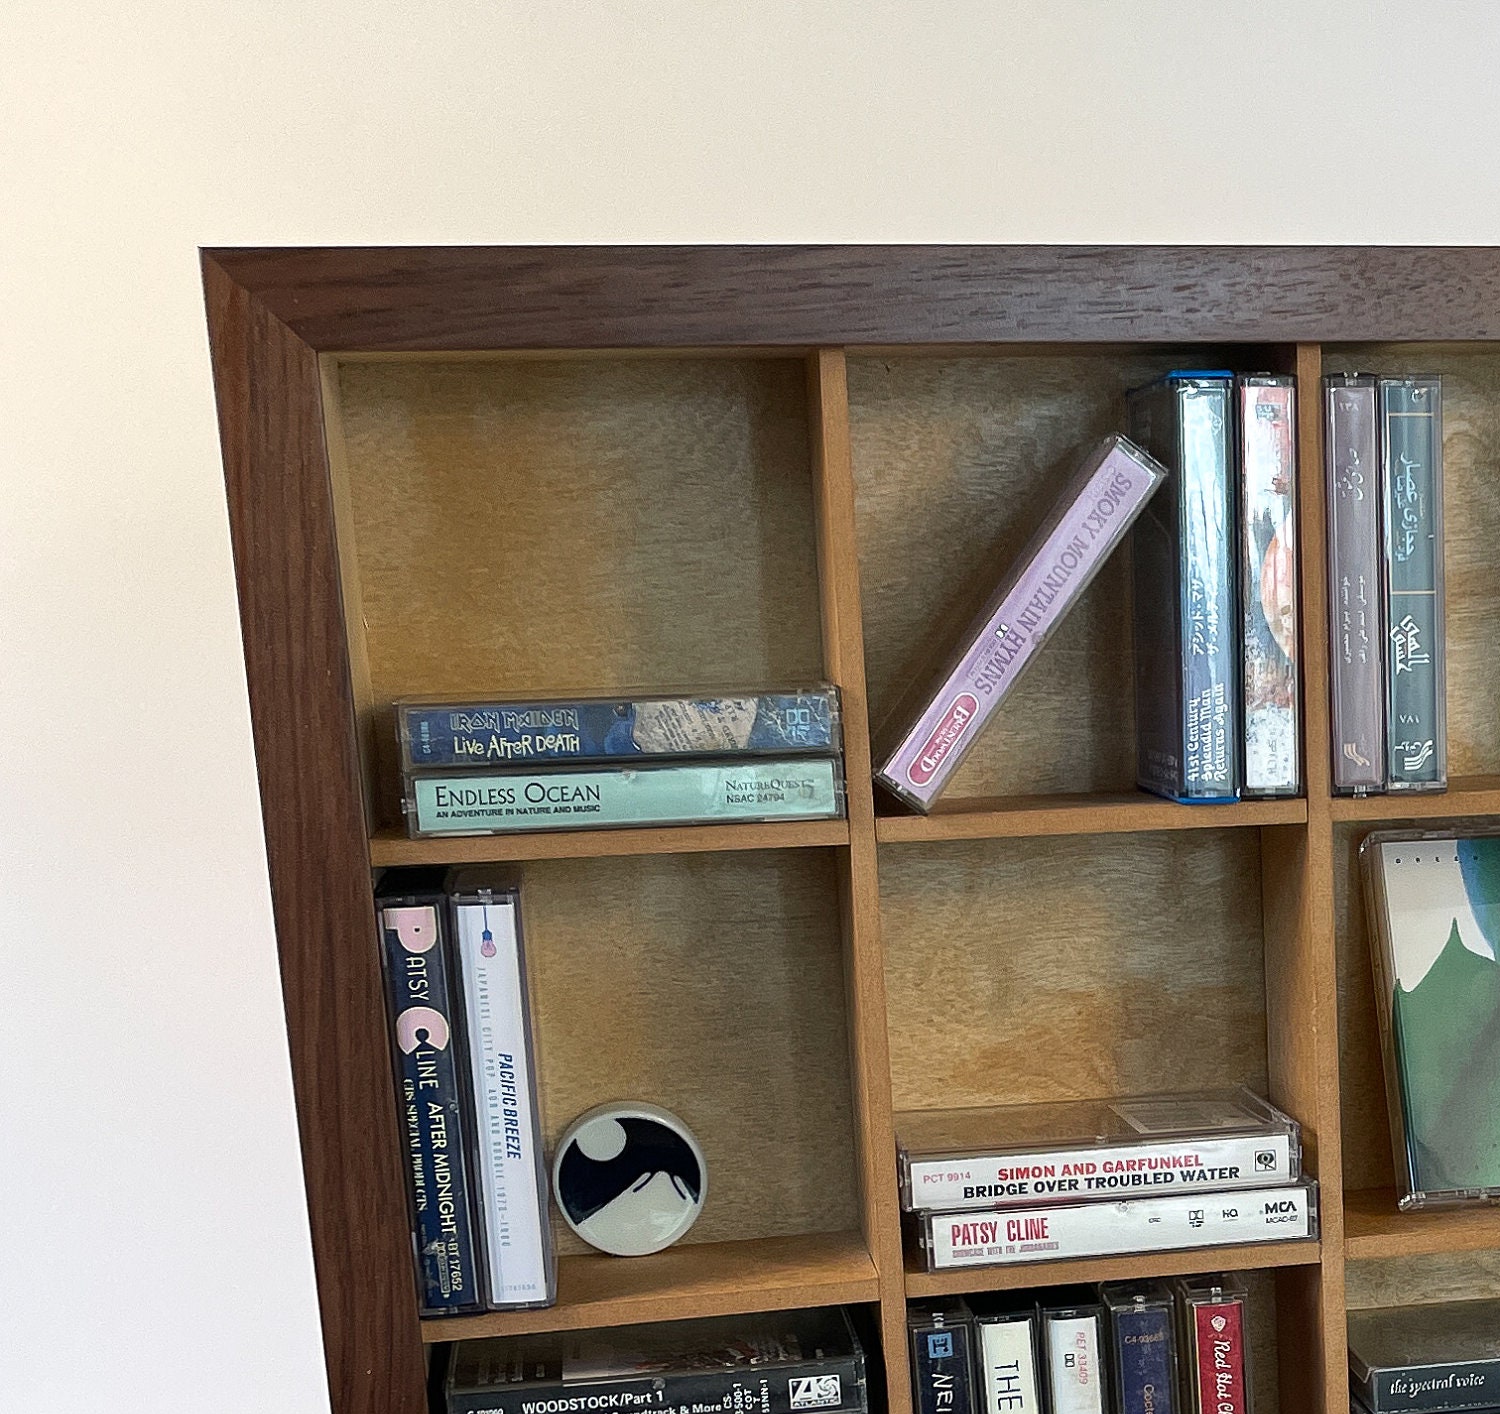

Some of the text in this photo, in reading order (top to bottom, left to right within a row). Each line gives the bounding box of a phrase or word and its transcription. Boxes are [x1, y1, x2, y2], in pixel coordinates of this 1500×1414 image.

[974, 473, 1132, 696] SMOKY MOUNTAIN HYMNS
[436, 782, 600, 806] ENDLESS OCEAN
[451, 809, 502, 817] ADVENTURE
[516, 807, 550, 815] NATURE
[384, 907, 457, 1244] PATSY CLINE AFTER MIDNIGHT
[499, 1053, 522, 1159] PACIFIC BREEZE
[963, 1167, 1240, 1199] BRIDGE OVER TROUBLED WATER
[998, 1155, 1204, 1181] SIMON AND GARFUNKEL
[951, 1218, 1049, 1246] PATSY CLINE
[995, 1360, 1022, 1410] THE
[691, 1403, 721, 1414] More
